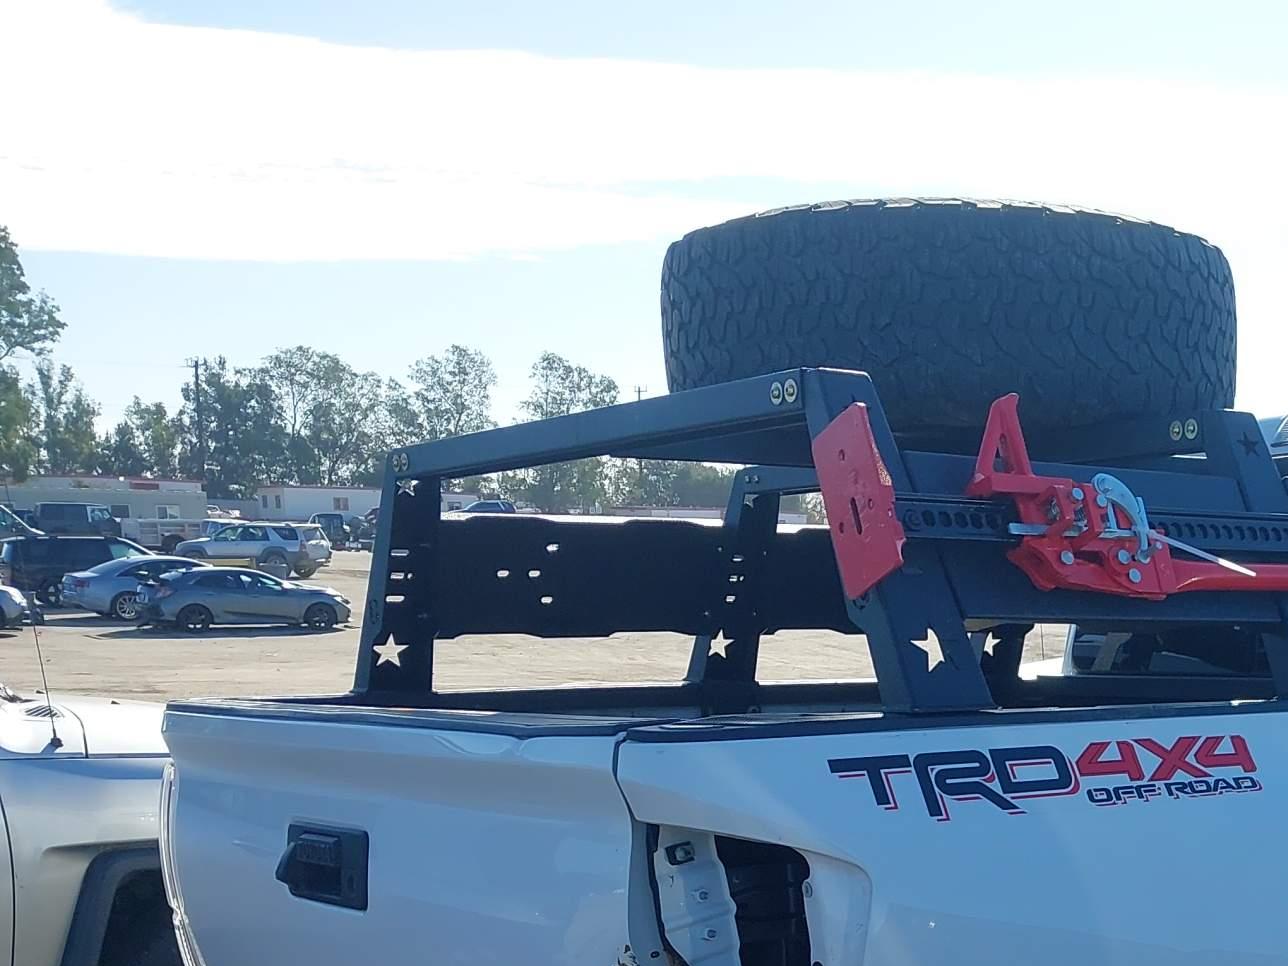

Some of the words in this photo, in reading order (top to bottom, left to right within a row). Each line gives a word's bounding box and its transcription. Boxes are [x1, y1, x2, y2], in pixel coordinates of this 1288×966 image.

[827, 744, 1081, 822] TRD
[1086, 782, 1159, 806] OFF
[1163, 774, 1263, 801] ROAD
